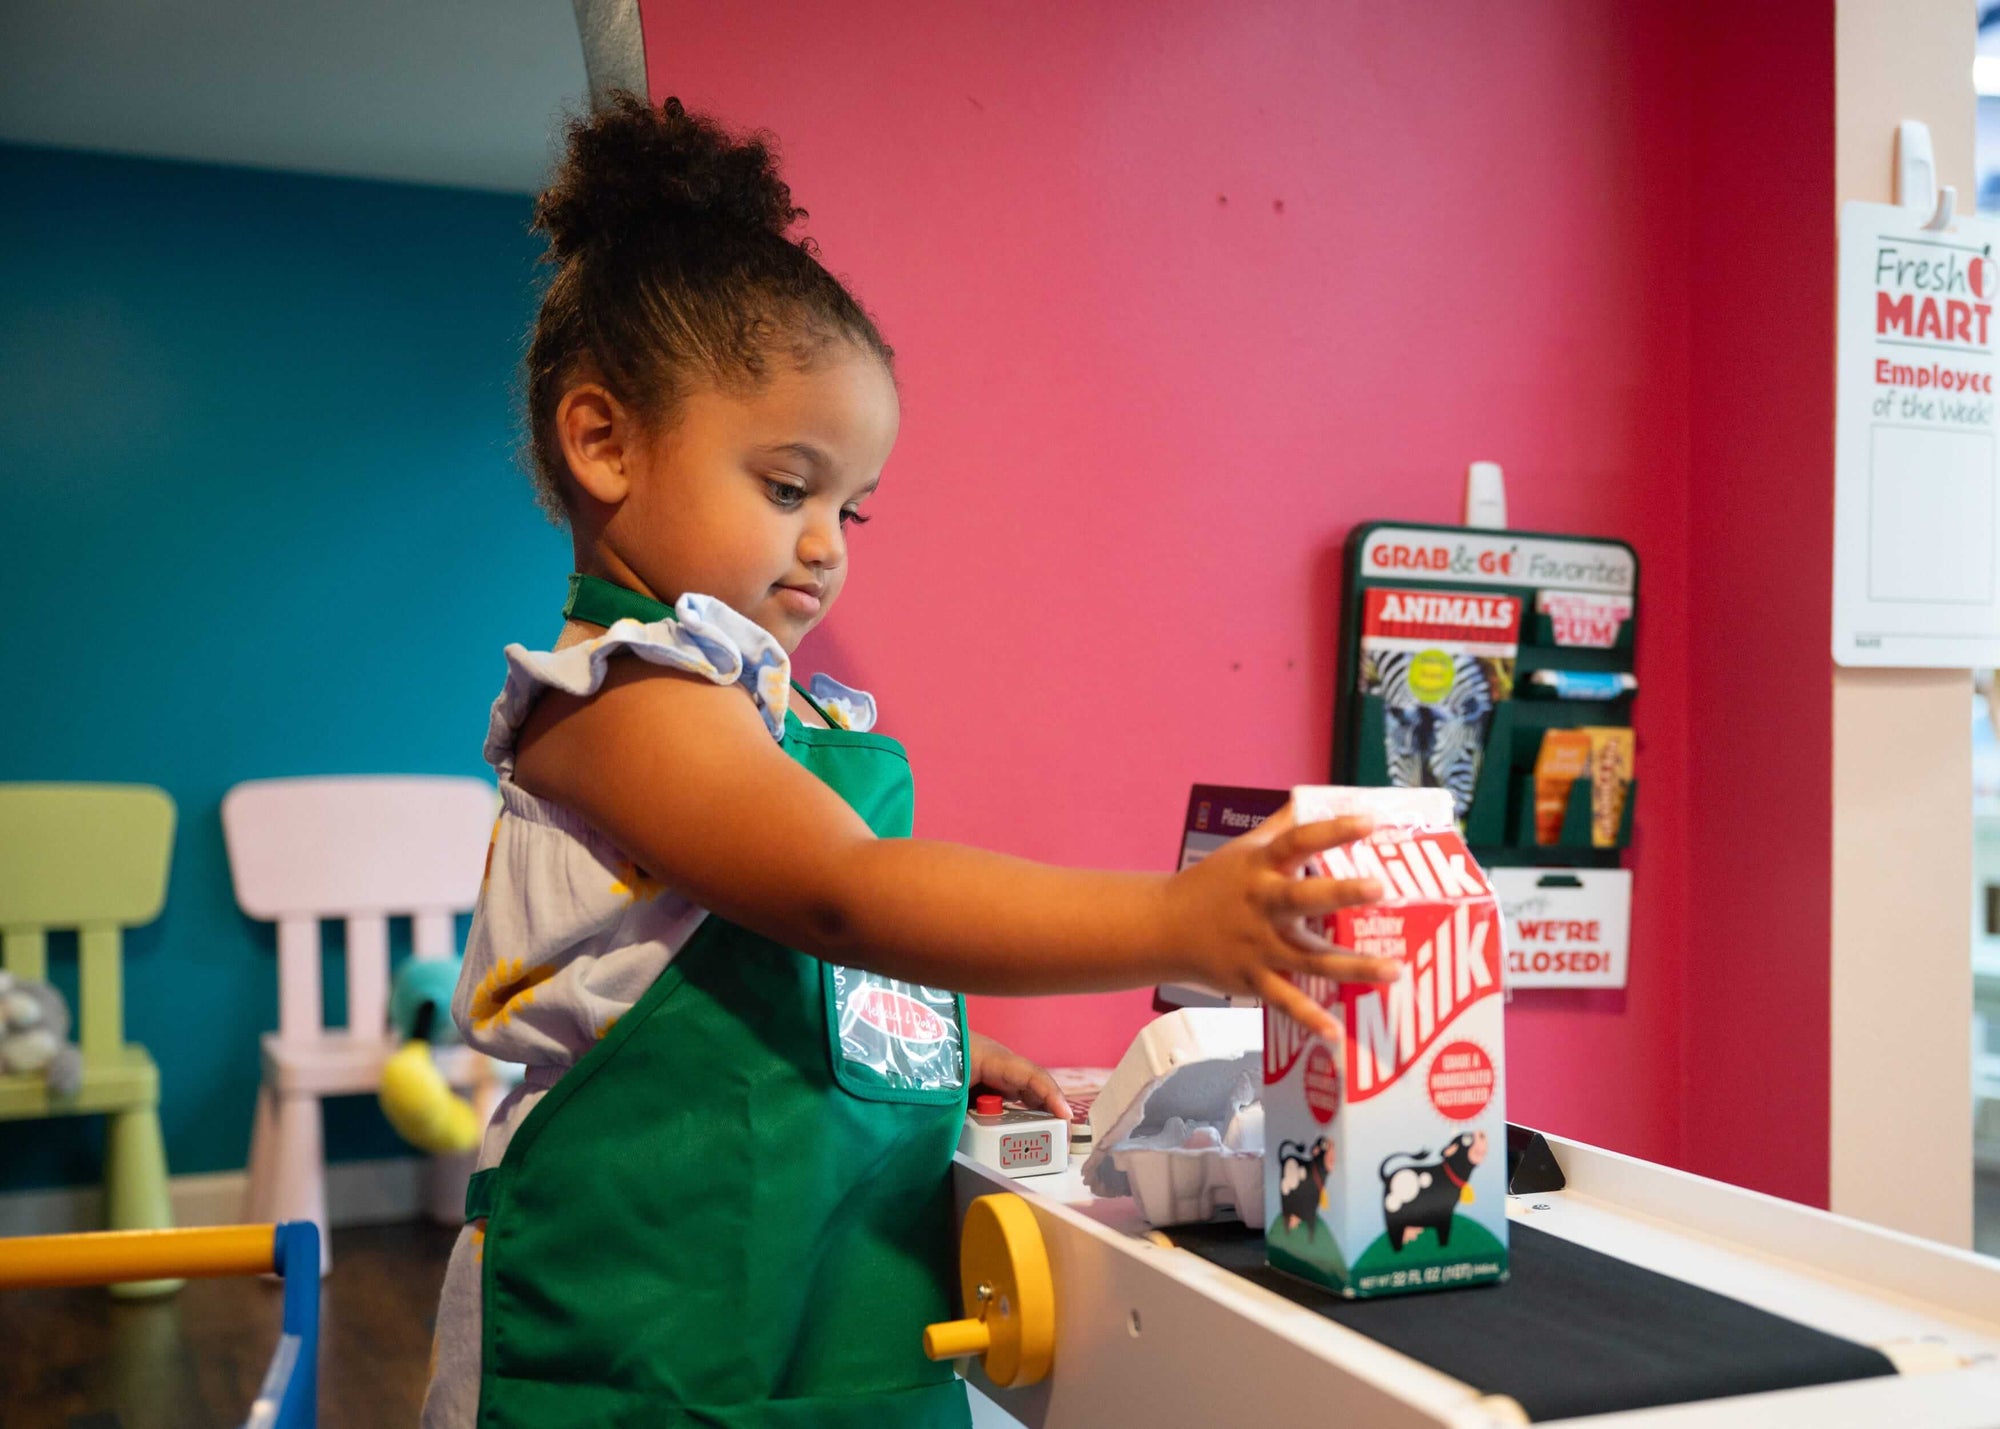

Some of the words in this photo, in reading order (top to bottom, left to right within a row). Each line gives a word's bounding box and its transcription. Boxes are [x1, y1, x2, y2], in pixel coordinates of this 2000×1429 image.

[1876, 248, 1966, 293] Fresh
[1876, 291, 1992, 345] MART
[1875, 358, 1992, 394] Employee
[1872, 389, 1896, 416] of
[1902, 392, 1934, 419] the
[1371, 544, 1450, 572] GRAB
[1528, 553, 1628, 586] Favorites
[1379, 594, 1513, 629] ANIMALS
[1221, 807, 1250, 828] Please
[1322, 838, 1486, 901] Milk
[1517, 919, 1600, 941] WE'RE
[1355, 902, 1493, 1093] Milk
[1391, 1270, 1408, 1288] 32
[1408, 1269, 1423, 1285] FL
[1423, 1266, 1441, 1283] OZ
